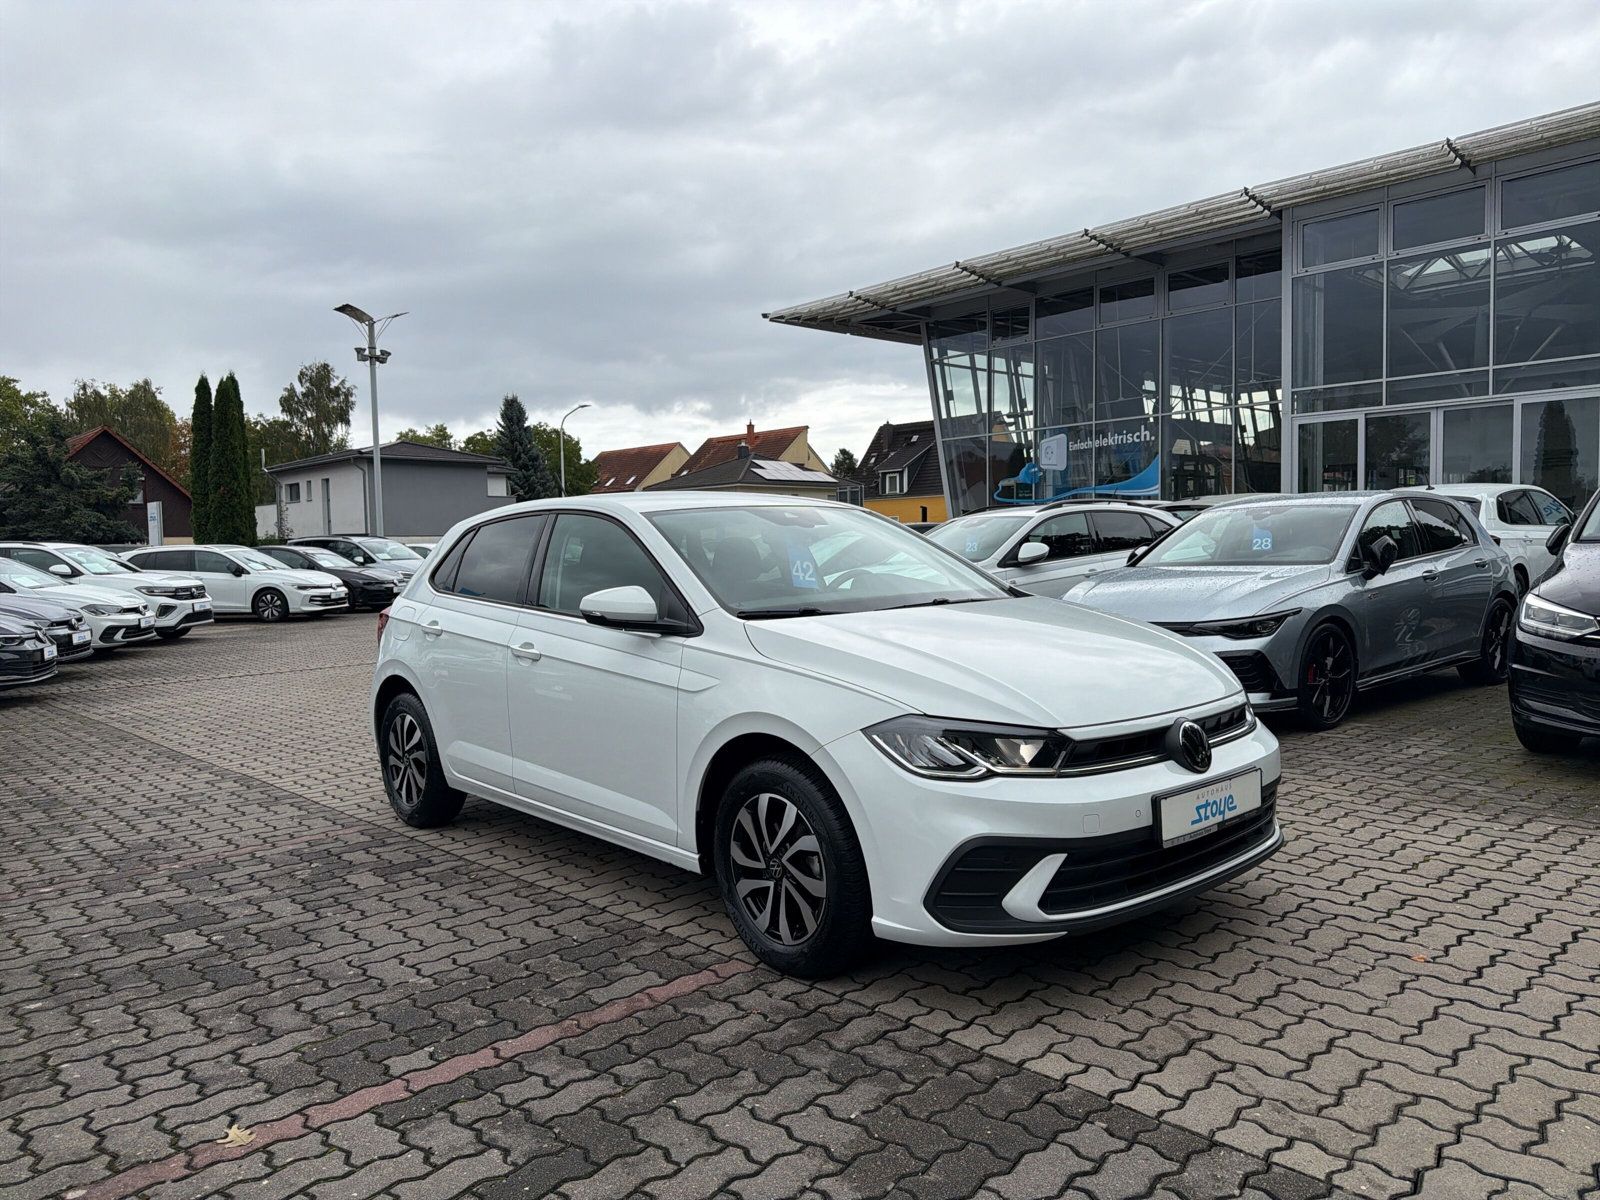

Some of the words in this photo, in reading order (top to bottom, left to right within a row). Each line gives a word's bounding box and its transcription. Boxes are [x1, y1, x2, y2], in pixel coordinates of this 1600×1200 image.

[1068, 436, 1093, 451] Einfach
[1095, 425, 1155, 448] elektrisch.
[1252, 537, 1271, 550] 28
[792, 560, 816, 581] 42
[1196, 782, 1232, 799] AUTOHAUS
